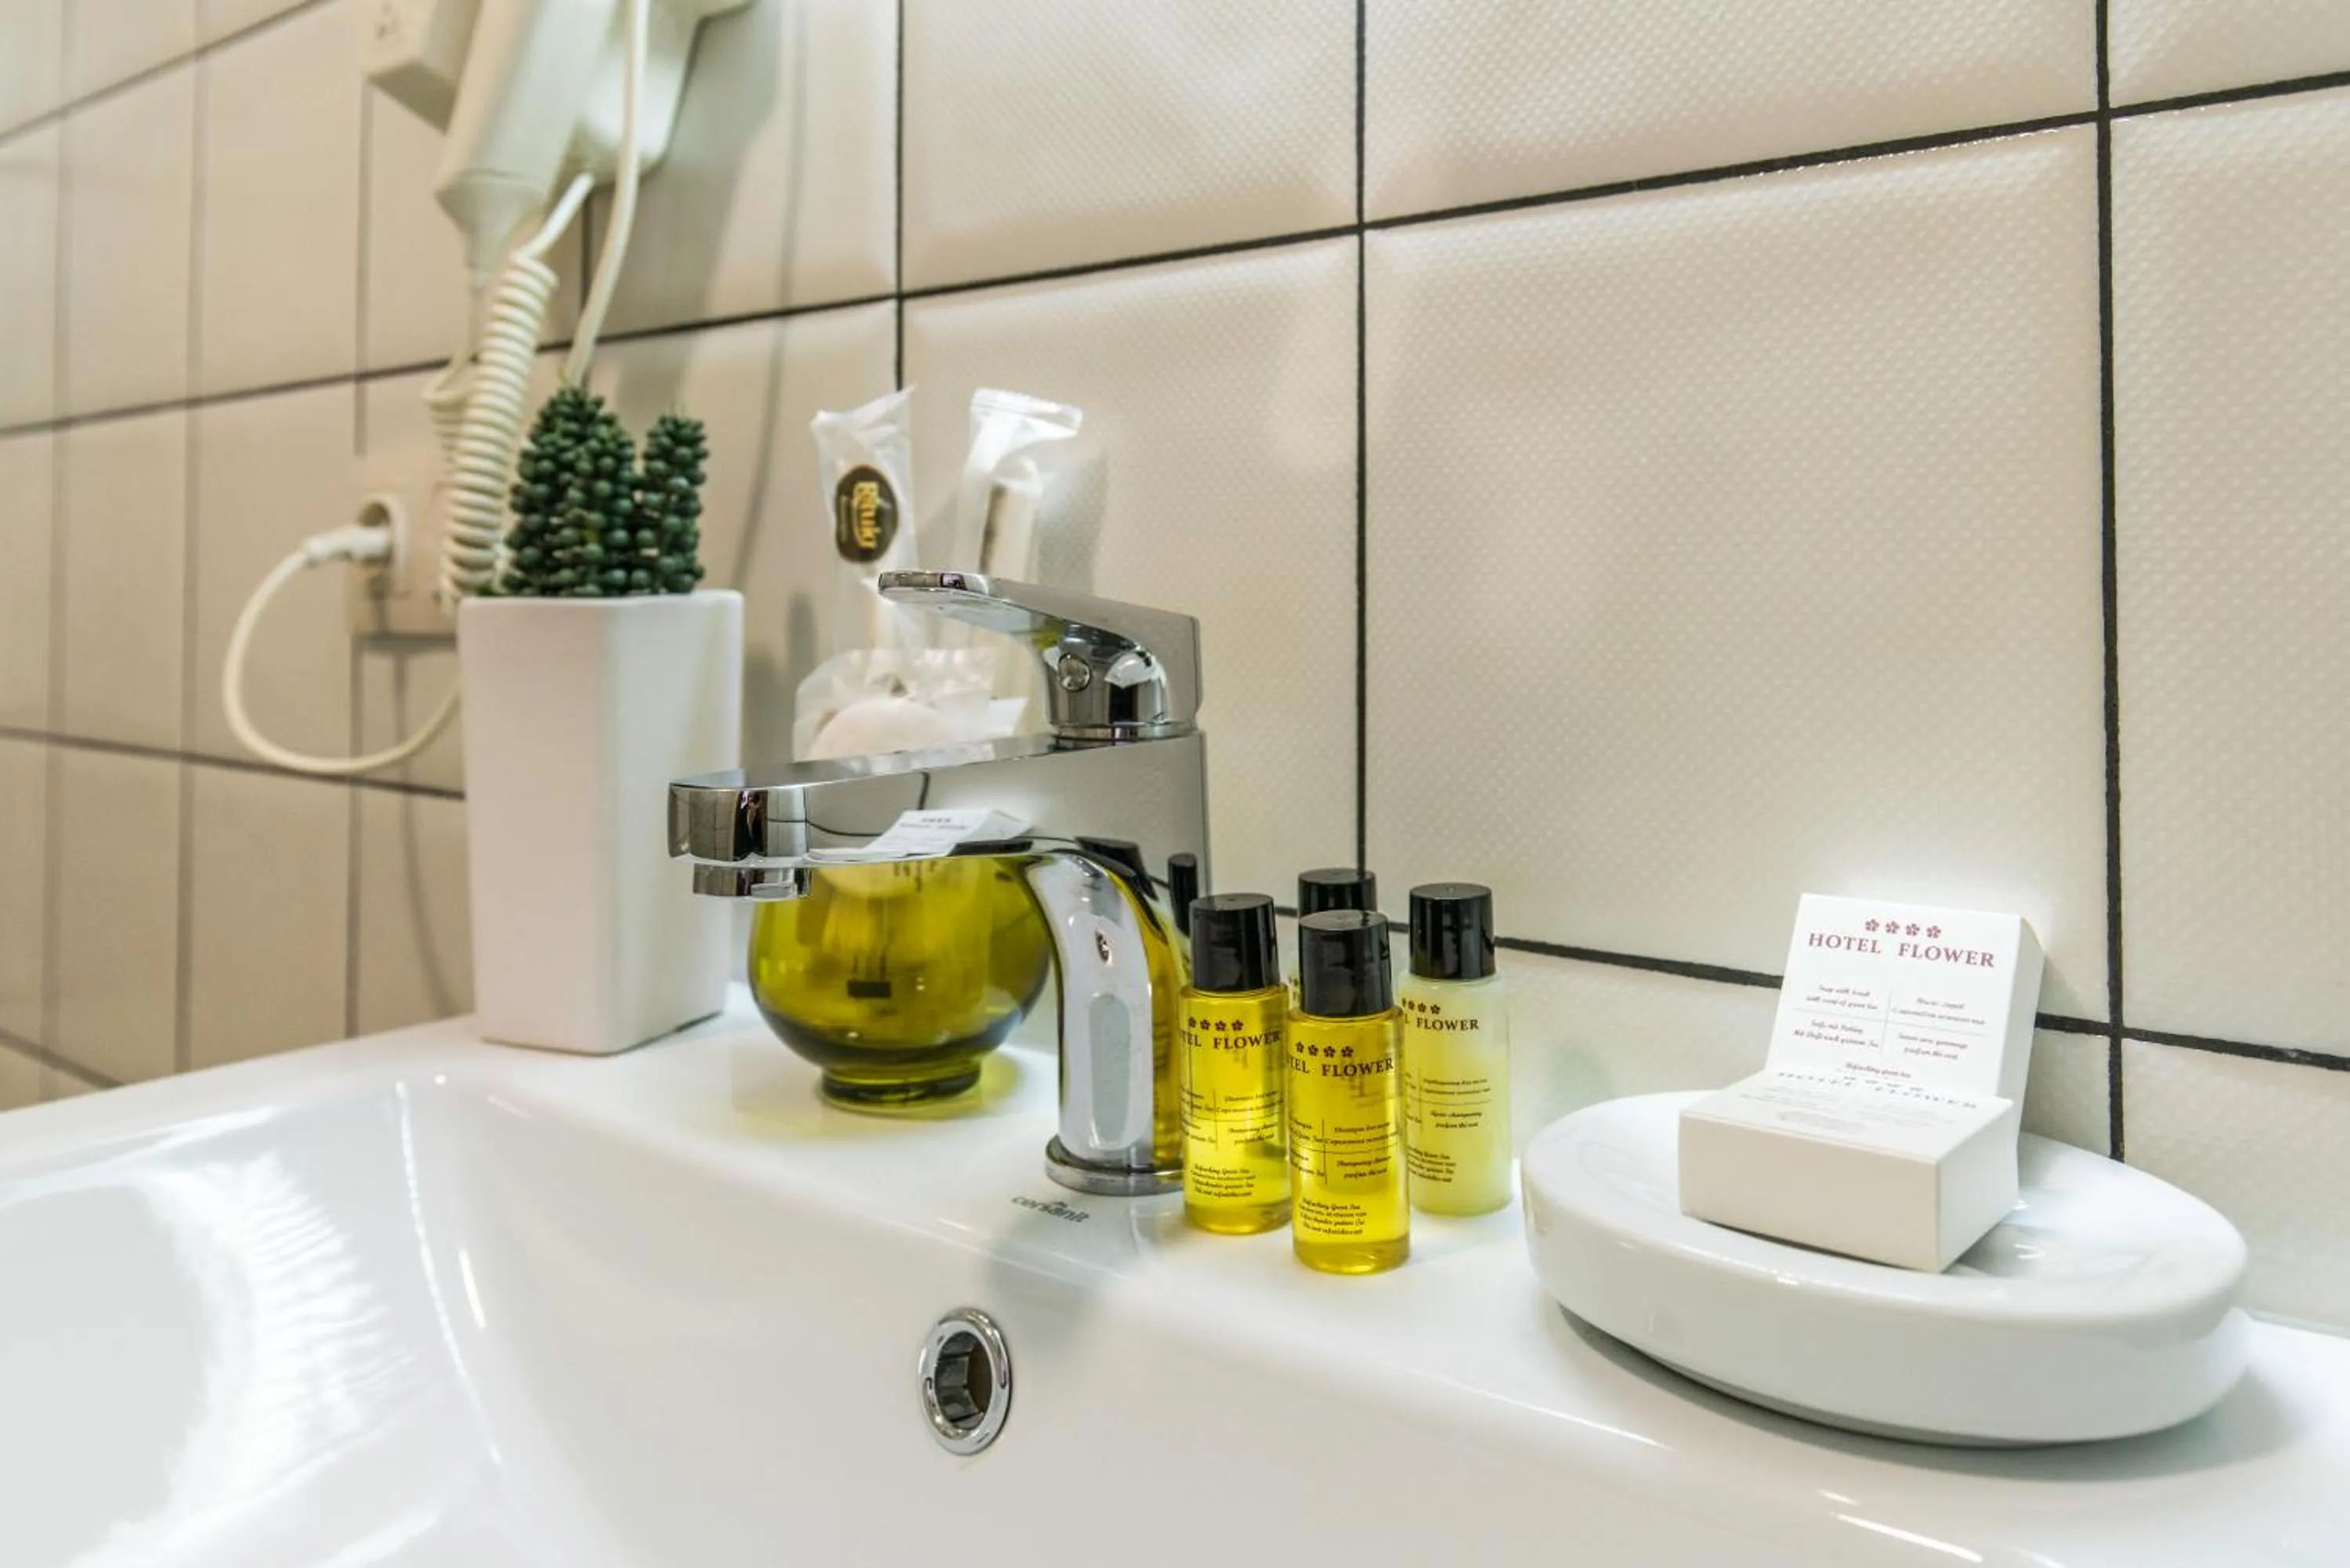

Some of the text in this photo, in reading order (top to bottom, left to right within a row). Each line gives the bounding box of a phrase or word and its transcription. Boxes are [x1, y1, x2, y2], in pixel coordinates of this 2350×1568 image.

[1808, 932, 1994, 968] HOTEL FLOWER
[1415, 1017, 1480, 1031] FLOWER
[1213, 1031, 1280, 1050] FLOWER
[1321, 1057, 1394, 1078] FLOWER
[1010, 1196, 1091, 1223] cersanit
